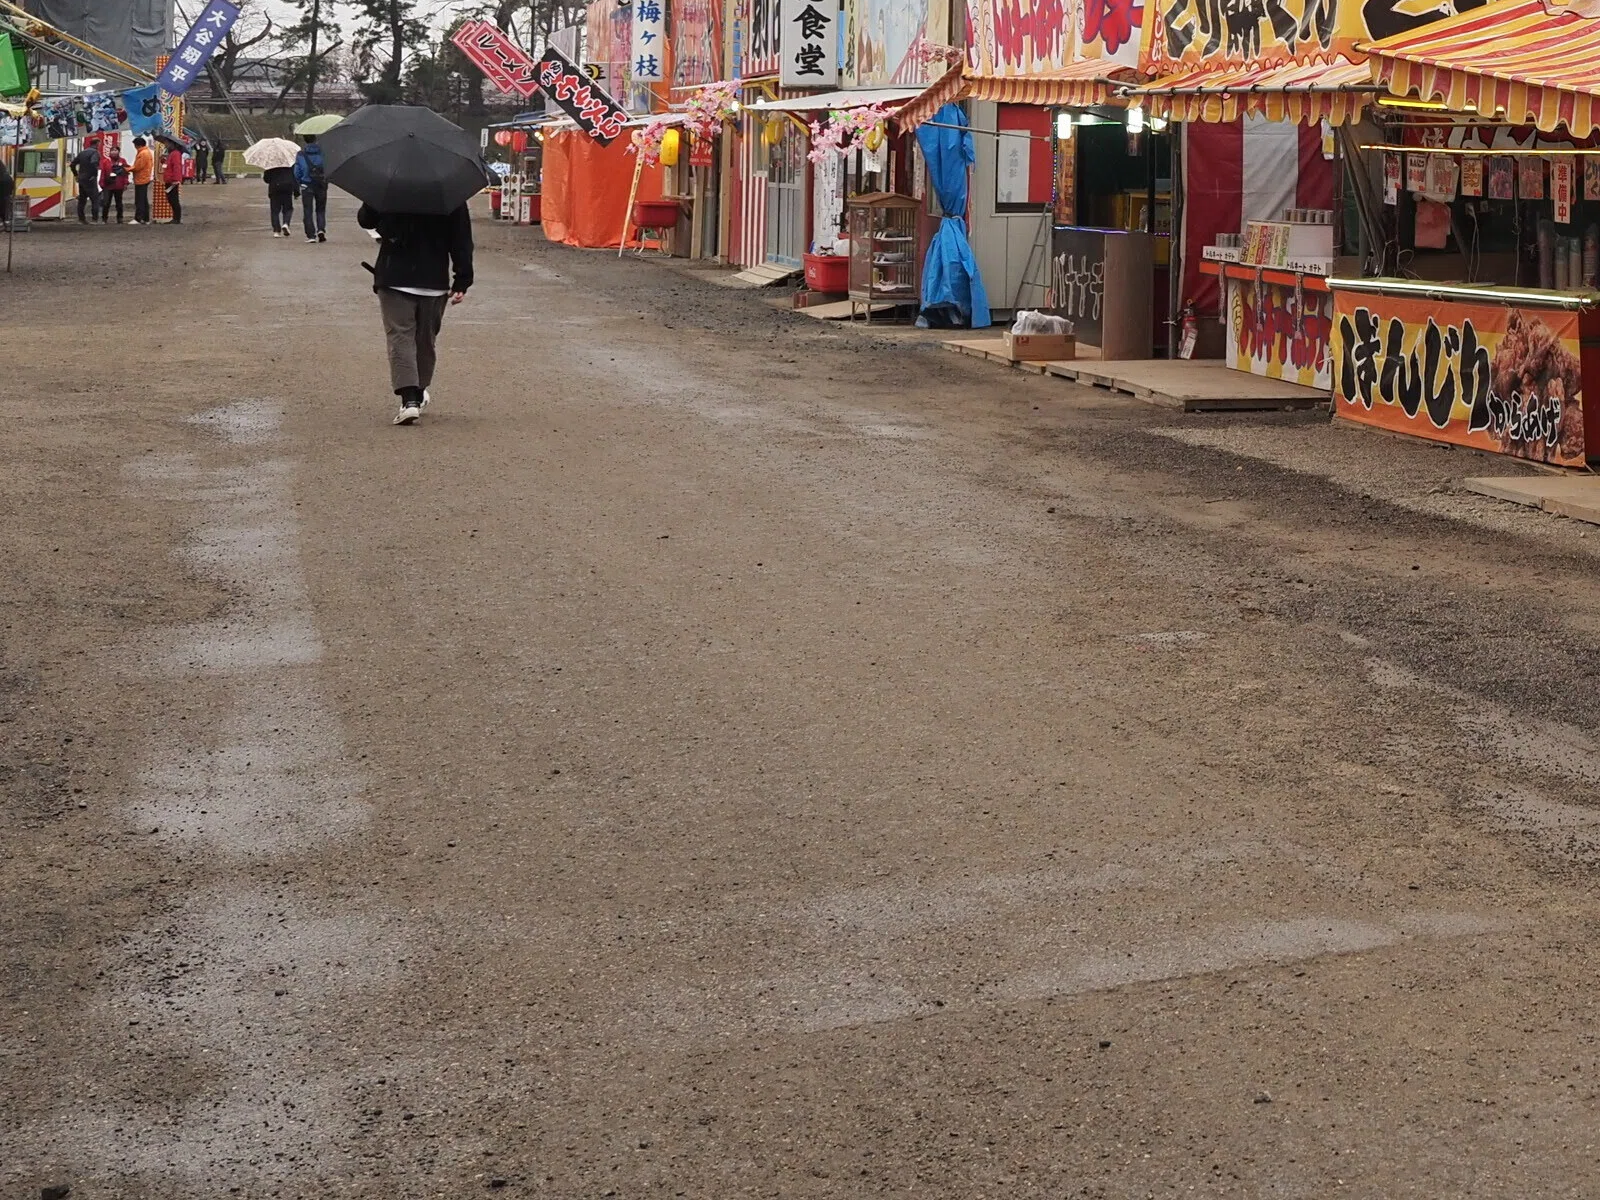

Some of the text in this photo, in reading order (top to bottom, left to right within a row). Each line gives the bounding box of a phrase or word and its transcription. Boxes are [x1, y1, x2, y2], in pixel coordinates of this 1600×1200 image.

[169, 10, 227, 82] 大谷翔平
[1557, 164, 1568, 221] 準備中
[1340, 306, 1491, 435] ぼんじり
[1490, 390, 1562, 448] からあげ
